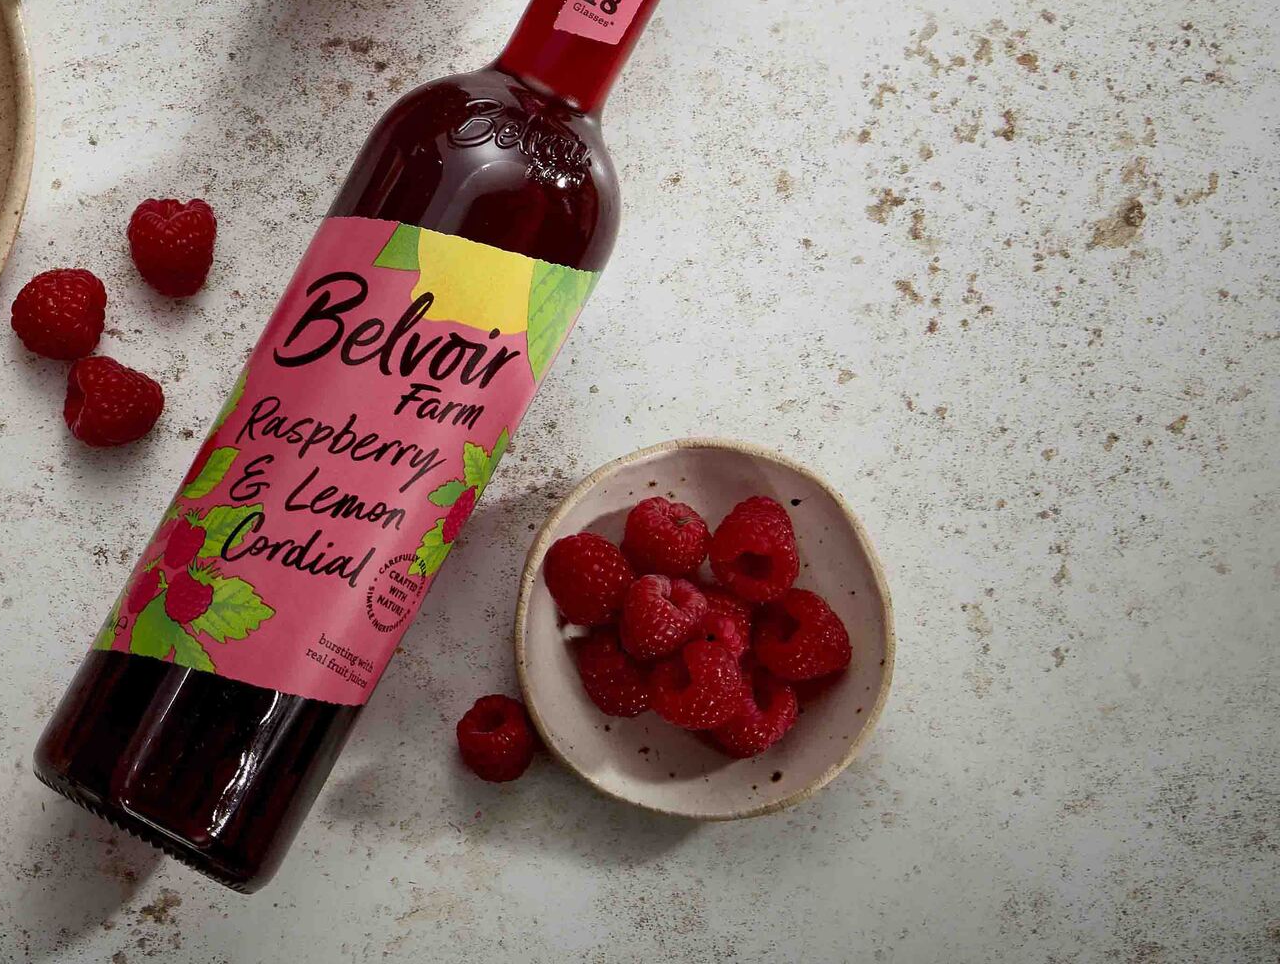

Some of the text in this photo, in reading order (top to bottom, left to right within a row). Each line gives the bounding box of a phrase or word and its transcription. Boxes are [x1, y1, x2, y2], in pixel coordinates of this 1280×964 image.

[273, 271, 521, 389] Belvoir
[394, 383, 485, 430] Farm
[235, 396, 447, 493] Raspberry
[229, 454, 406, 530] & Lemon
[220, 511, 376, 588] Cordial
[378, 553, 420, 574] CAREFULLY
[389, 570, 418, 592] CRAFTED
[389, 585, 408, 602] WITH
[366, 585, 376, 621] SIMPLE
[376, 594, 405, 617] NATURE
[306, 648, 328, 666] real
[326, 658, 350, 678] fruit
[318, 633, 374, 673] bursting with
